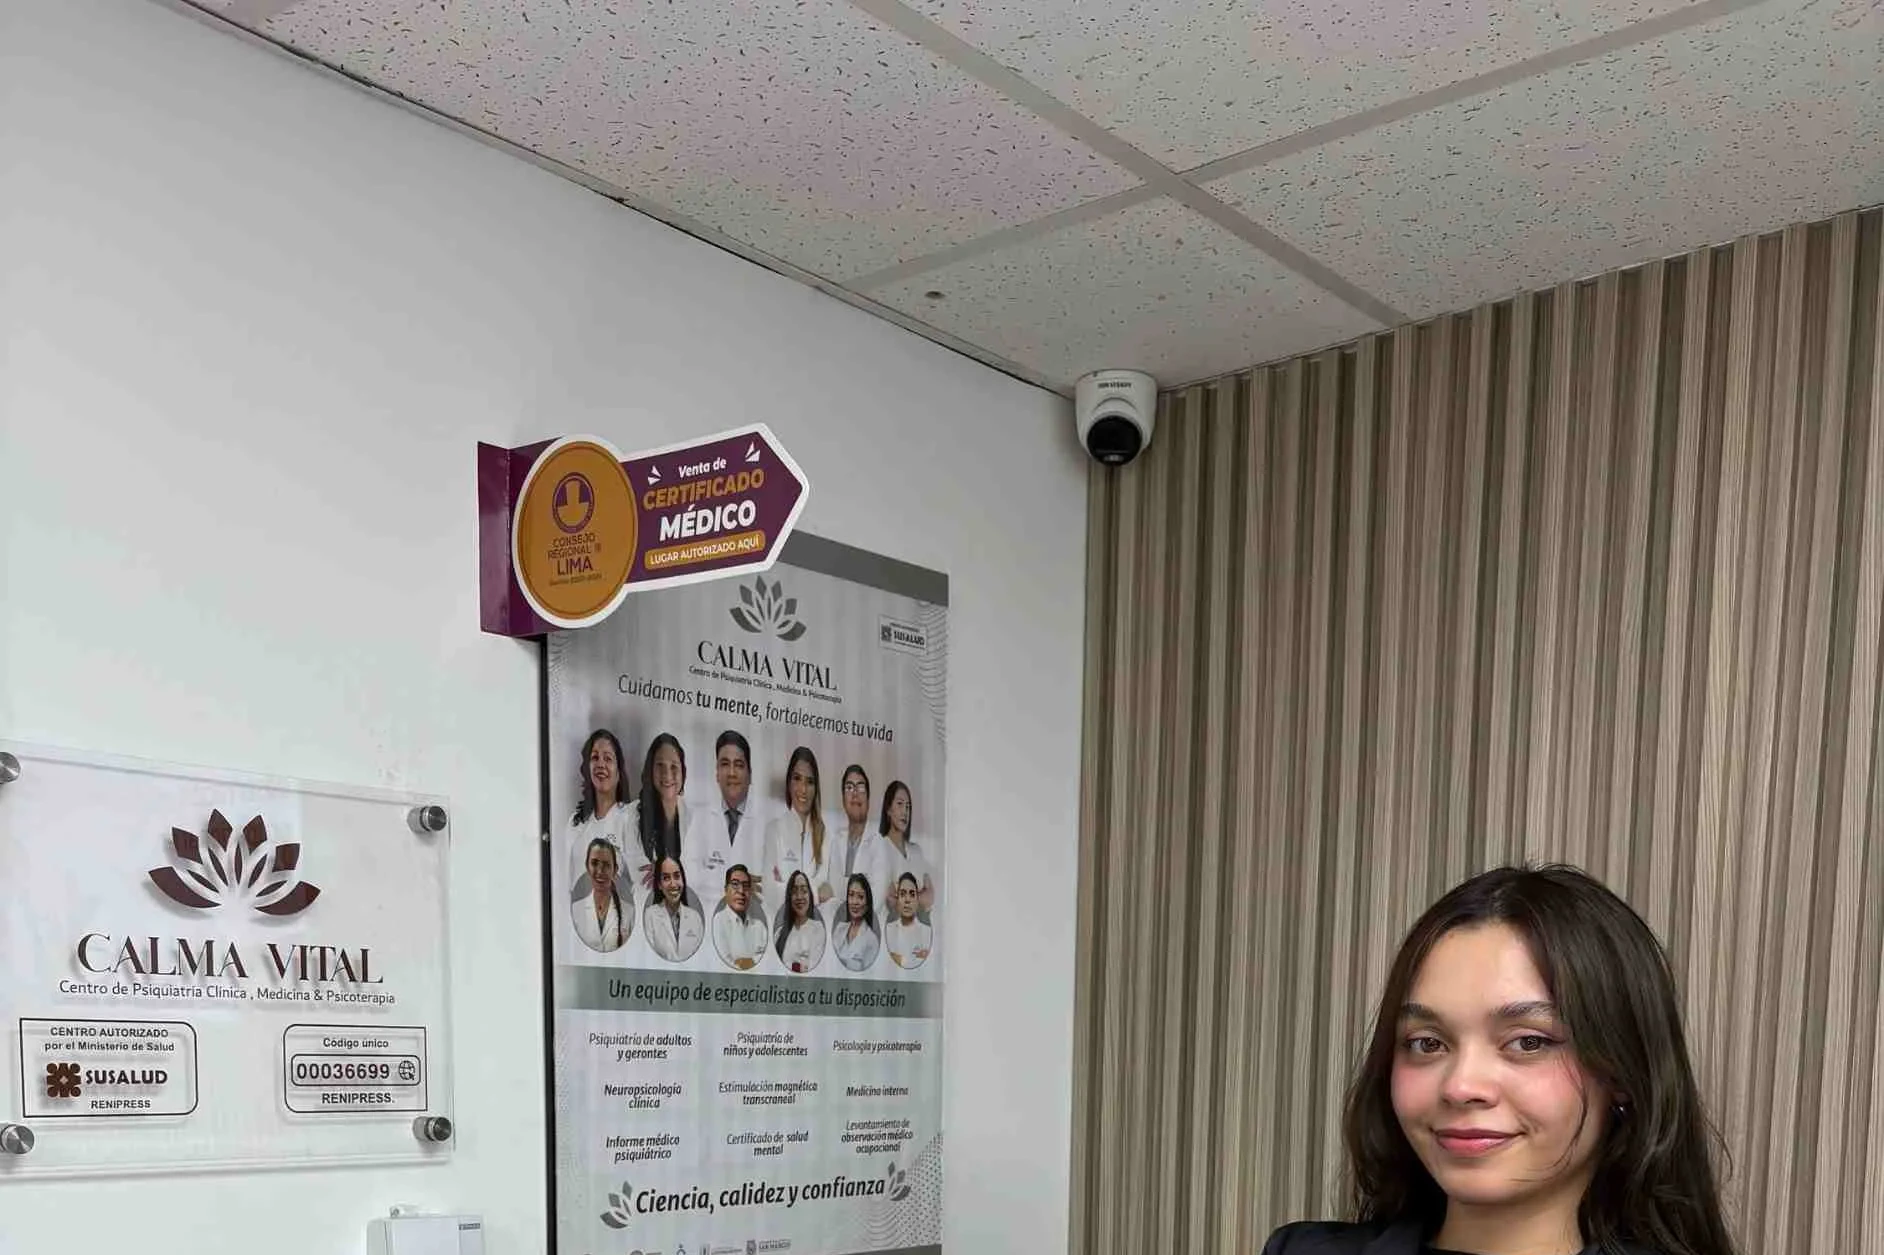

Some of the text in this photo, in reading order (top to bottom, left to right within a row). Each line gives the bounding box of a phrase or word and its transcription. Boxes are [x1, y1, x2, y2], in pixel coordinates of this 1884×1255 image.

[679, 458, 726, 479] Venta de
[643, 469, 764, 510] CERTIFICADO
[660, 500, 756, 541] MÉDICO
[552, 532, 595, 547] CONSEJO
[650, 535, 759, 565] LUGAR AUTORIZADO AQUÍ
[558, 556, 593, 575] LIMA
[698, 640, 837, 691] CALMA VITAL
[618, 675, 893, 742] Cuidamos tu mente, fortalecemos tu vida
[77, 932, 383, 984] CALMA VITAL
[59, 980, 110, 995] Centro
[112, 981, 129, 996] de
[256, 988, 311, 1001] Medicina
[314, 990, 324, 1001] &
[326, 990, 395, 1005] Psicoterapia
[609, 979, 905, 1010] Un equipo de especialistas a tu disposición
[50, 1027, 169, 1038] CENTRO AUTORIZADO
[589, 1033, 692, 1047] Psiquiatría de adultos
[44, 1041, 174, 1053] por el Ministerio de Salud
[323, 1037, 359, 1050] Código
[617, 1048, 667, 1062] y gerontes
[723, 1045, 808, 1058] niños y adolescentes
[85, 1068, 168, 1085] SUSALUD
[296, 1062, 390, 1080] 00036699
[604, 1083, 681, 1099] Neuropsicología
[718, 1080, 818, 1094] Estimulación magnética
[846, 1086, 908, 1097] Medicina interna
[91, 1099, 151, 1109] RENIPRESS
[628, 1096, 660, 1110] clínica
[742, 1093, 796, 1105] transcraneal
[606, 1134, 680, 1148] Informe médico
[727, 1131, 809, 1145] Certificado de salud
[614, 1147, 672, 1164] psiquiátrico
[753, 1145, 784, 1157] mental
[636, 1177, 885, 1216] Ciencia, calidez y confianza
